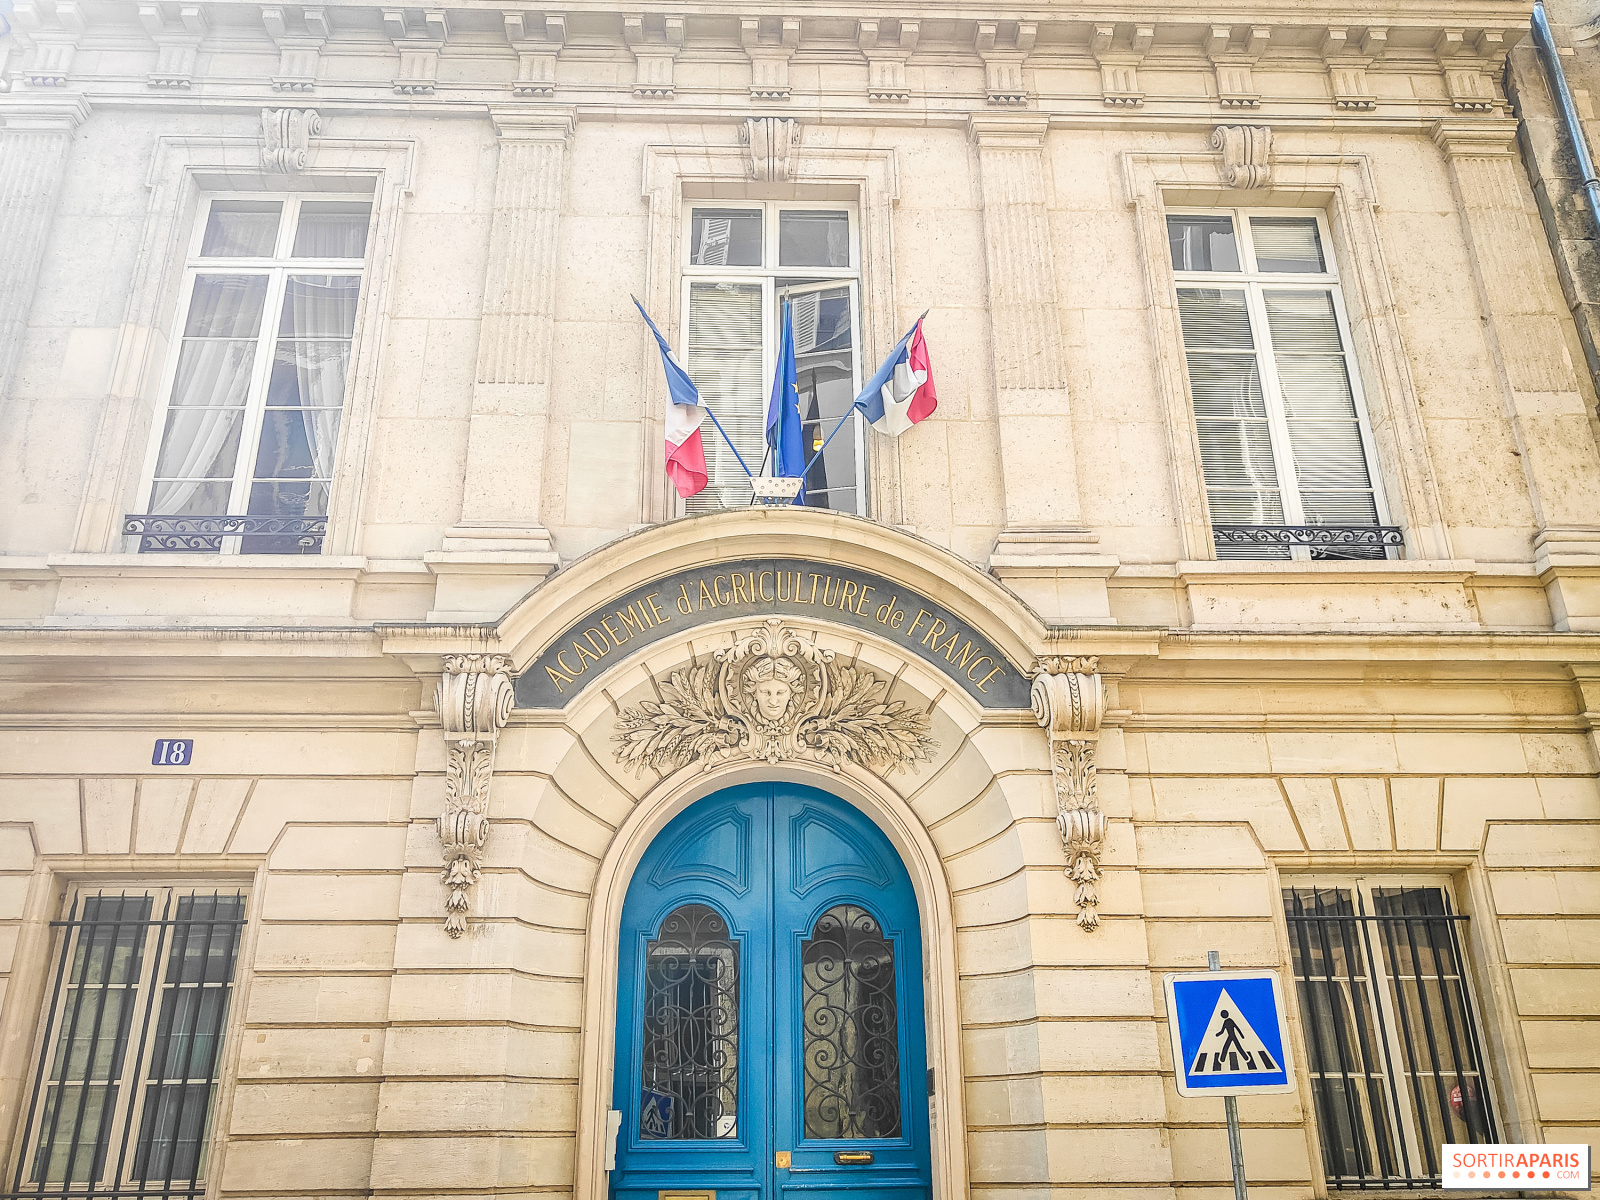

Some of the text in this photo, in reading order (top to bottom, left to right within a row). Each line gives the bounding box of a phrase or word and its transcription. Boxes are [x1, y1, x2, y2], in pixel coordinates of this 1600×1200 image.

[544, 571, 1006, 693] ACADÉMIE d'AGRICULTURE de FRANCE
[158, 741, 186, 764] 18
